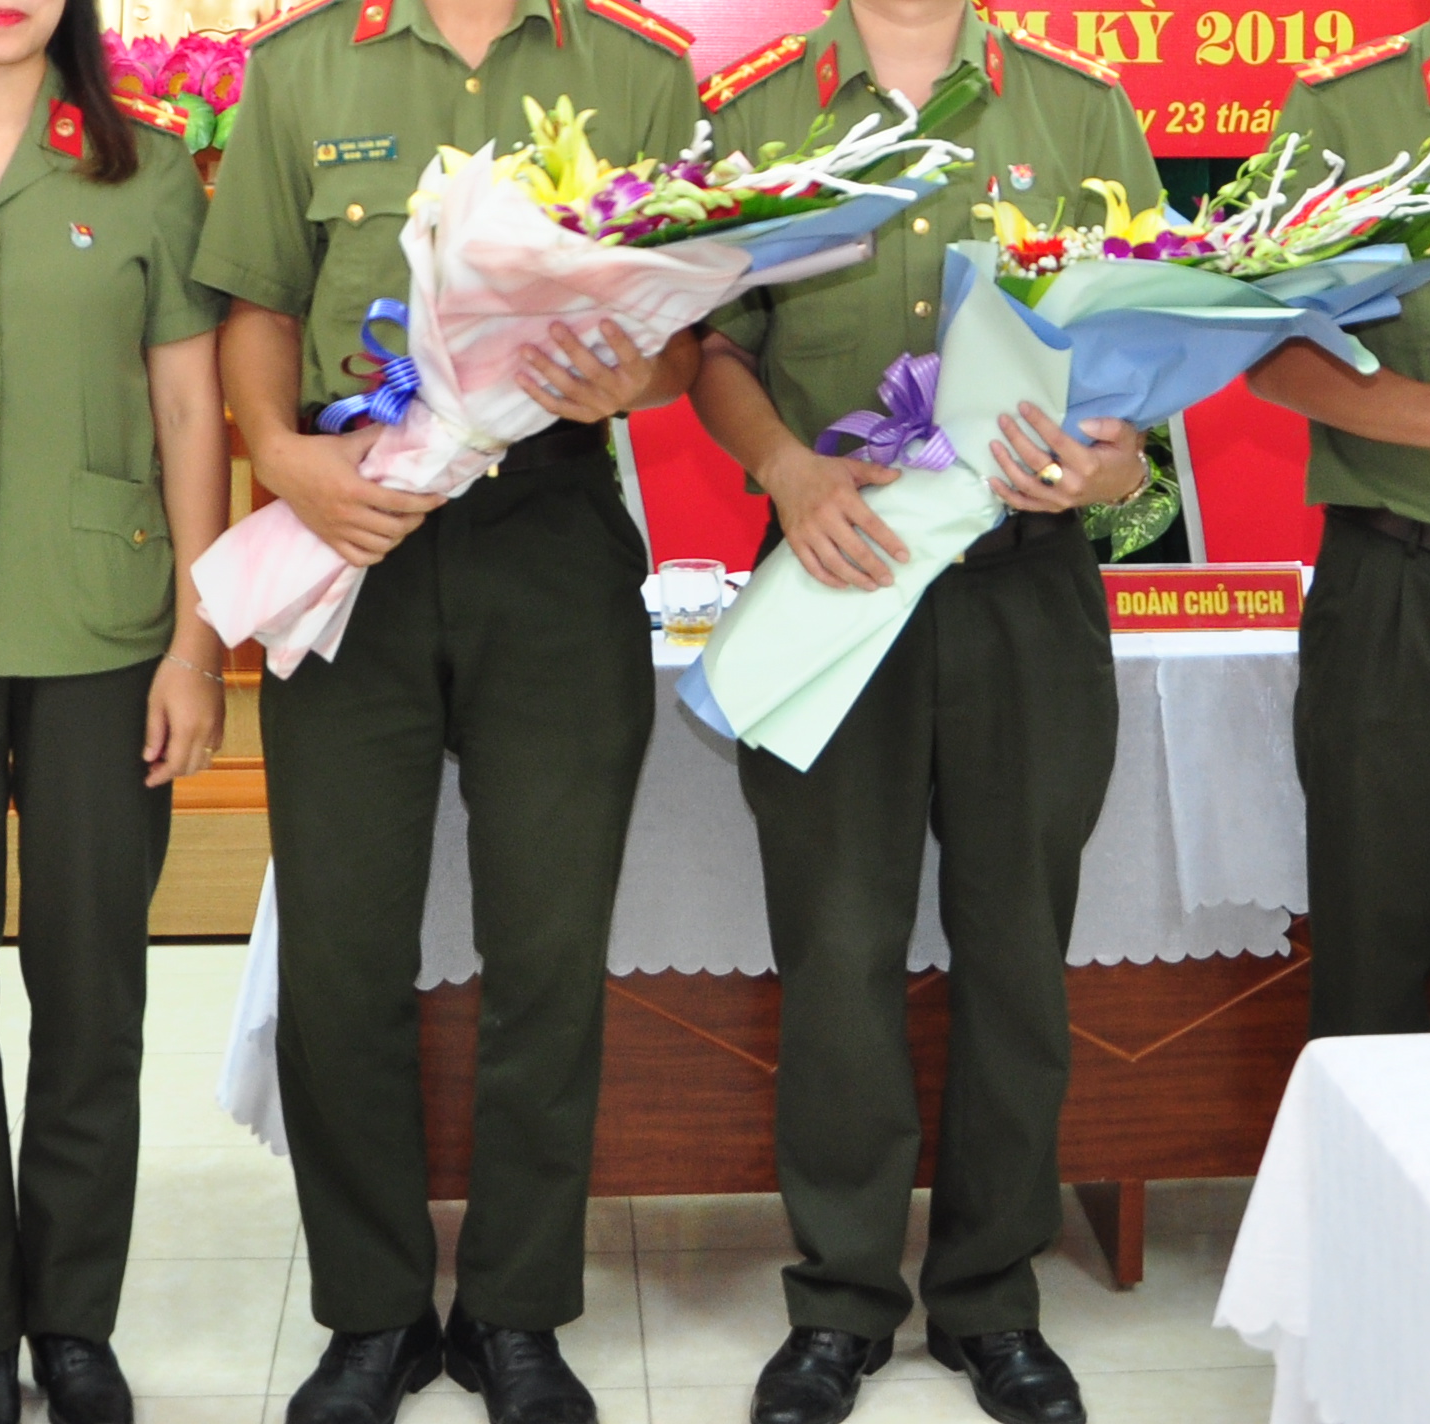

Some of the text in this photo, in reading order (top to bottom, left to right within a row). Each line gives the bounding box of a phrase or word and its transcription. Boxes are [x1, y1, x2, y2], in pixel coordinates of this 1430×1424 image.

[1195, 9, 1355, 66] 2019
[1165, 100, 1206, 134] 23
[1216, 99, 1282, 134] thá
[1116, 582, 1285, 620] ĐOÀN CHỦ TỊCH
